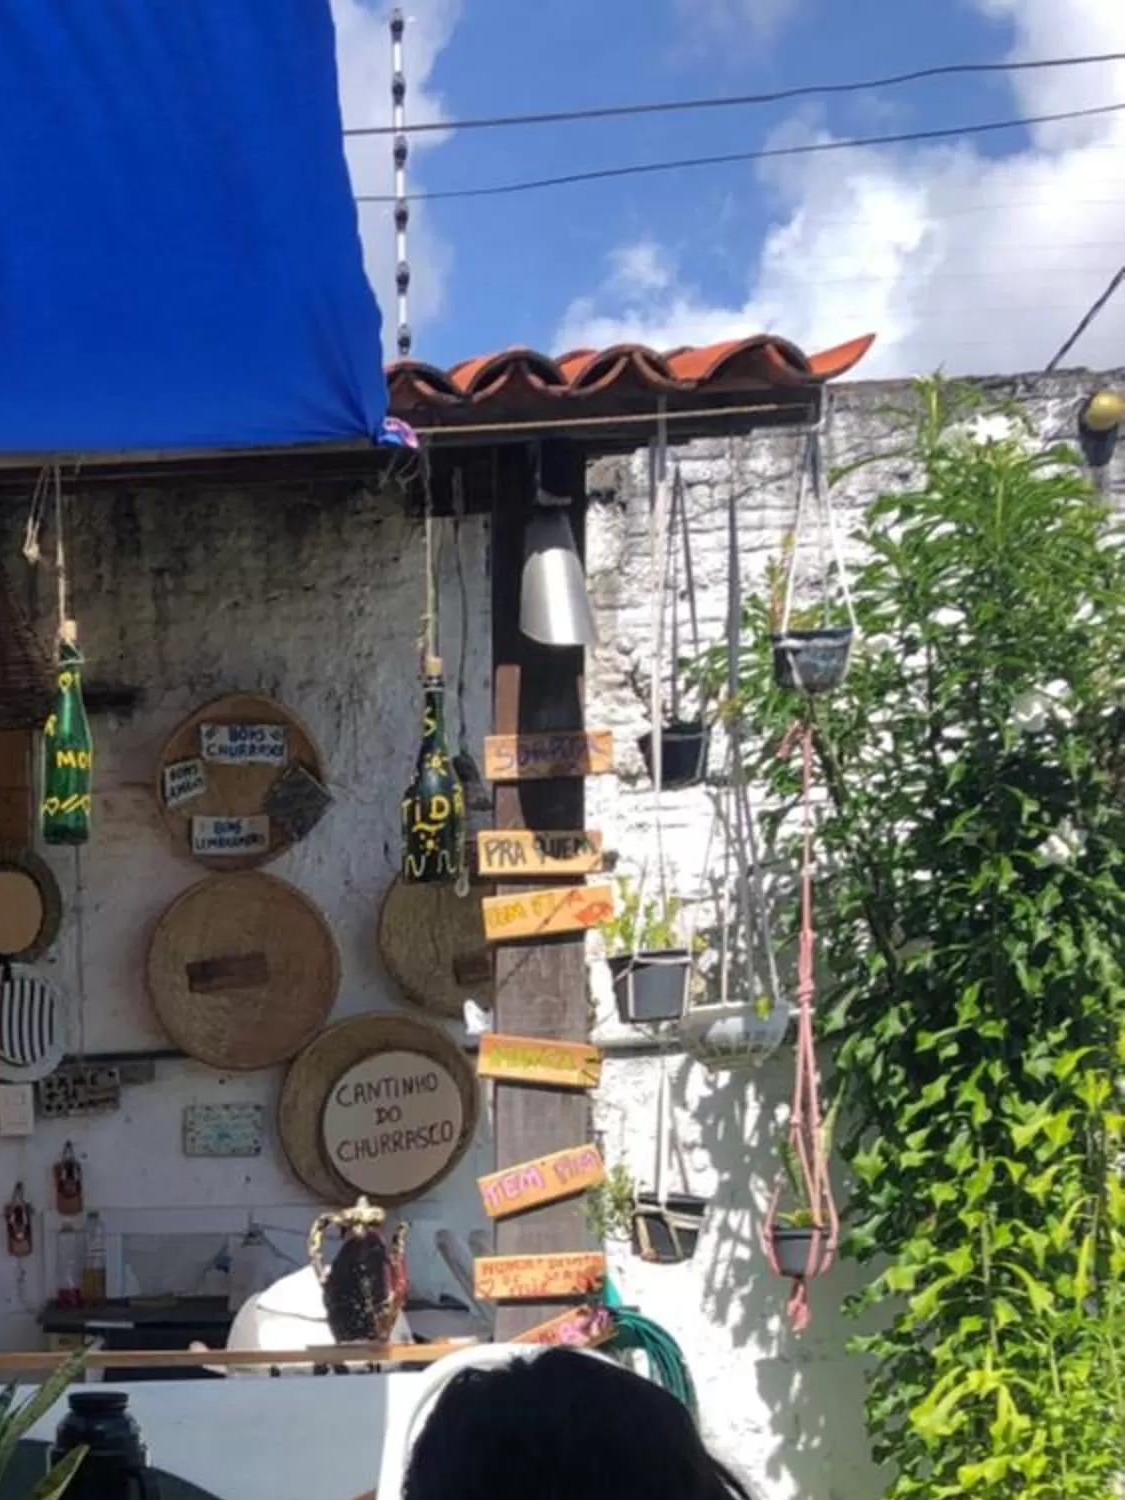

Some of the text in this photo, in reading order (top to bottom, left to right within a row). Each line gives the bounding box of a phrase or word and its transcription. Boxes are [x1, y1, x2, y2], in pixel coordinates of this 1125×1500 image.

[484, 838, 527, 867] PRA
[336, 1072, 438, 1107] CANTINHO
[375, 1105, 402, 1125] DO
[337, 1120, 454, 1161] CHURRASCO
[482, 1165, 546, 1208] TEM
